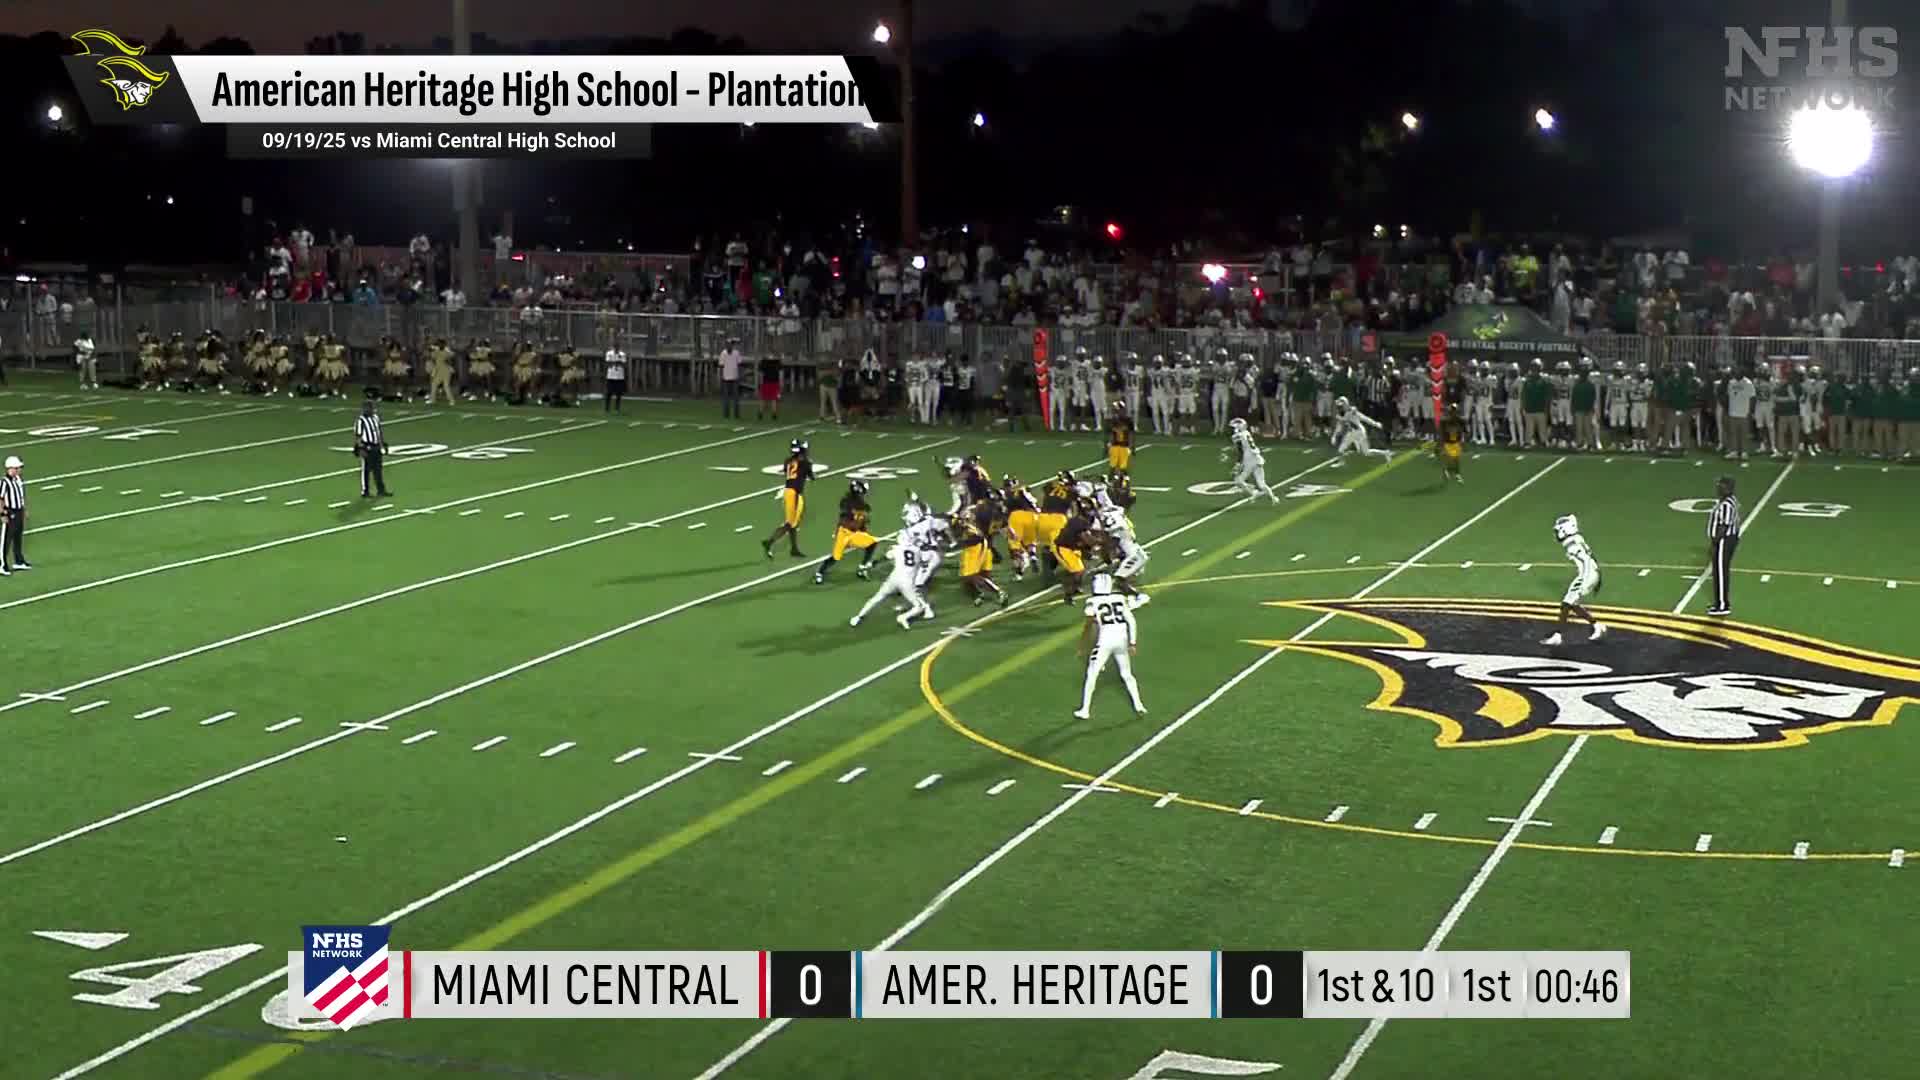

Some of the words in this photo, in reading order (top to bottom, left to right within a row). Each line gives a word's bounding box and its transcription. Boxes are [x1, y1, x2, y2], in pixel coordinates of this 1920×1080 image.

[786, 461, 799, 479] 12
[904, 549, 915, 567] 8
[1099, 604, 1126, 624] 25
